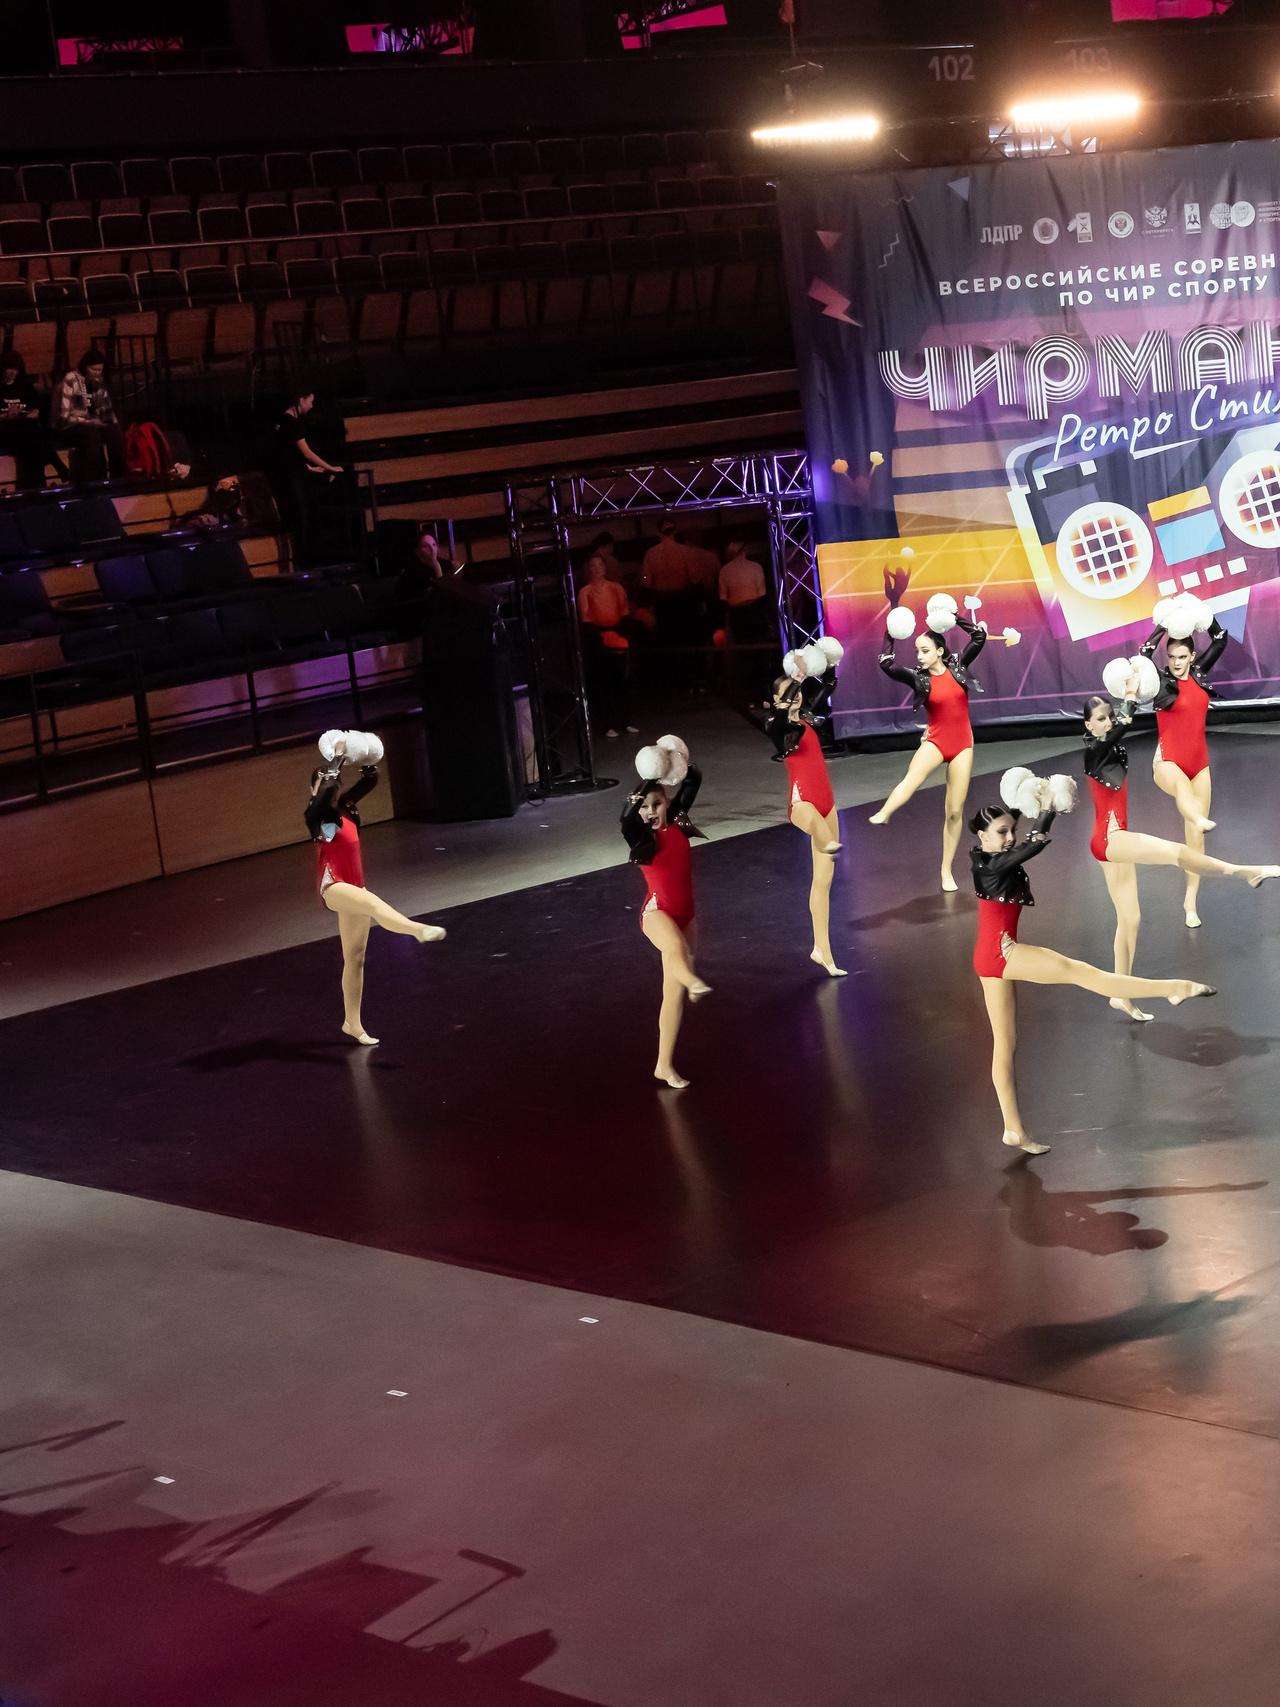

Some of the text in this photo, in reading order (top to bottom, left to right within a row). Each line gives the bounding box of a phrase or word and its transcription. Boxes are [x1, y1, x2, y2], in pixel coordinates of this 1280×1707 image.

[928, 54, 975, 82] 102
[1065, 47, 1112, 73] 103
[981, 224, 1023, 245] ЛДПР
[938, 263, 1162, 296] ВСЕРОССИЙСКИЕ
[1059, 275, 1268, 307] ПО ЧИР СПОРТУ
[1053, 412, 1174, 462] Ретро
